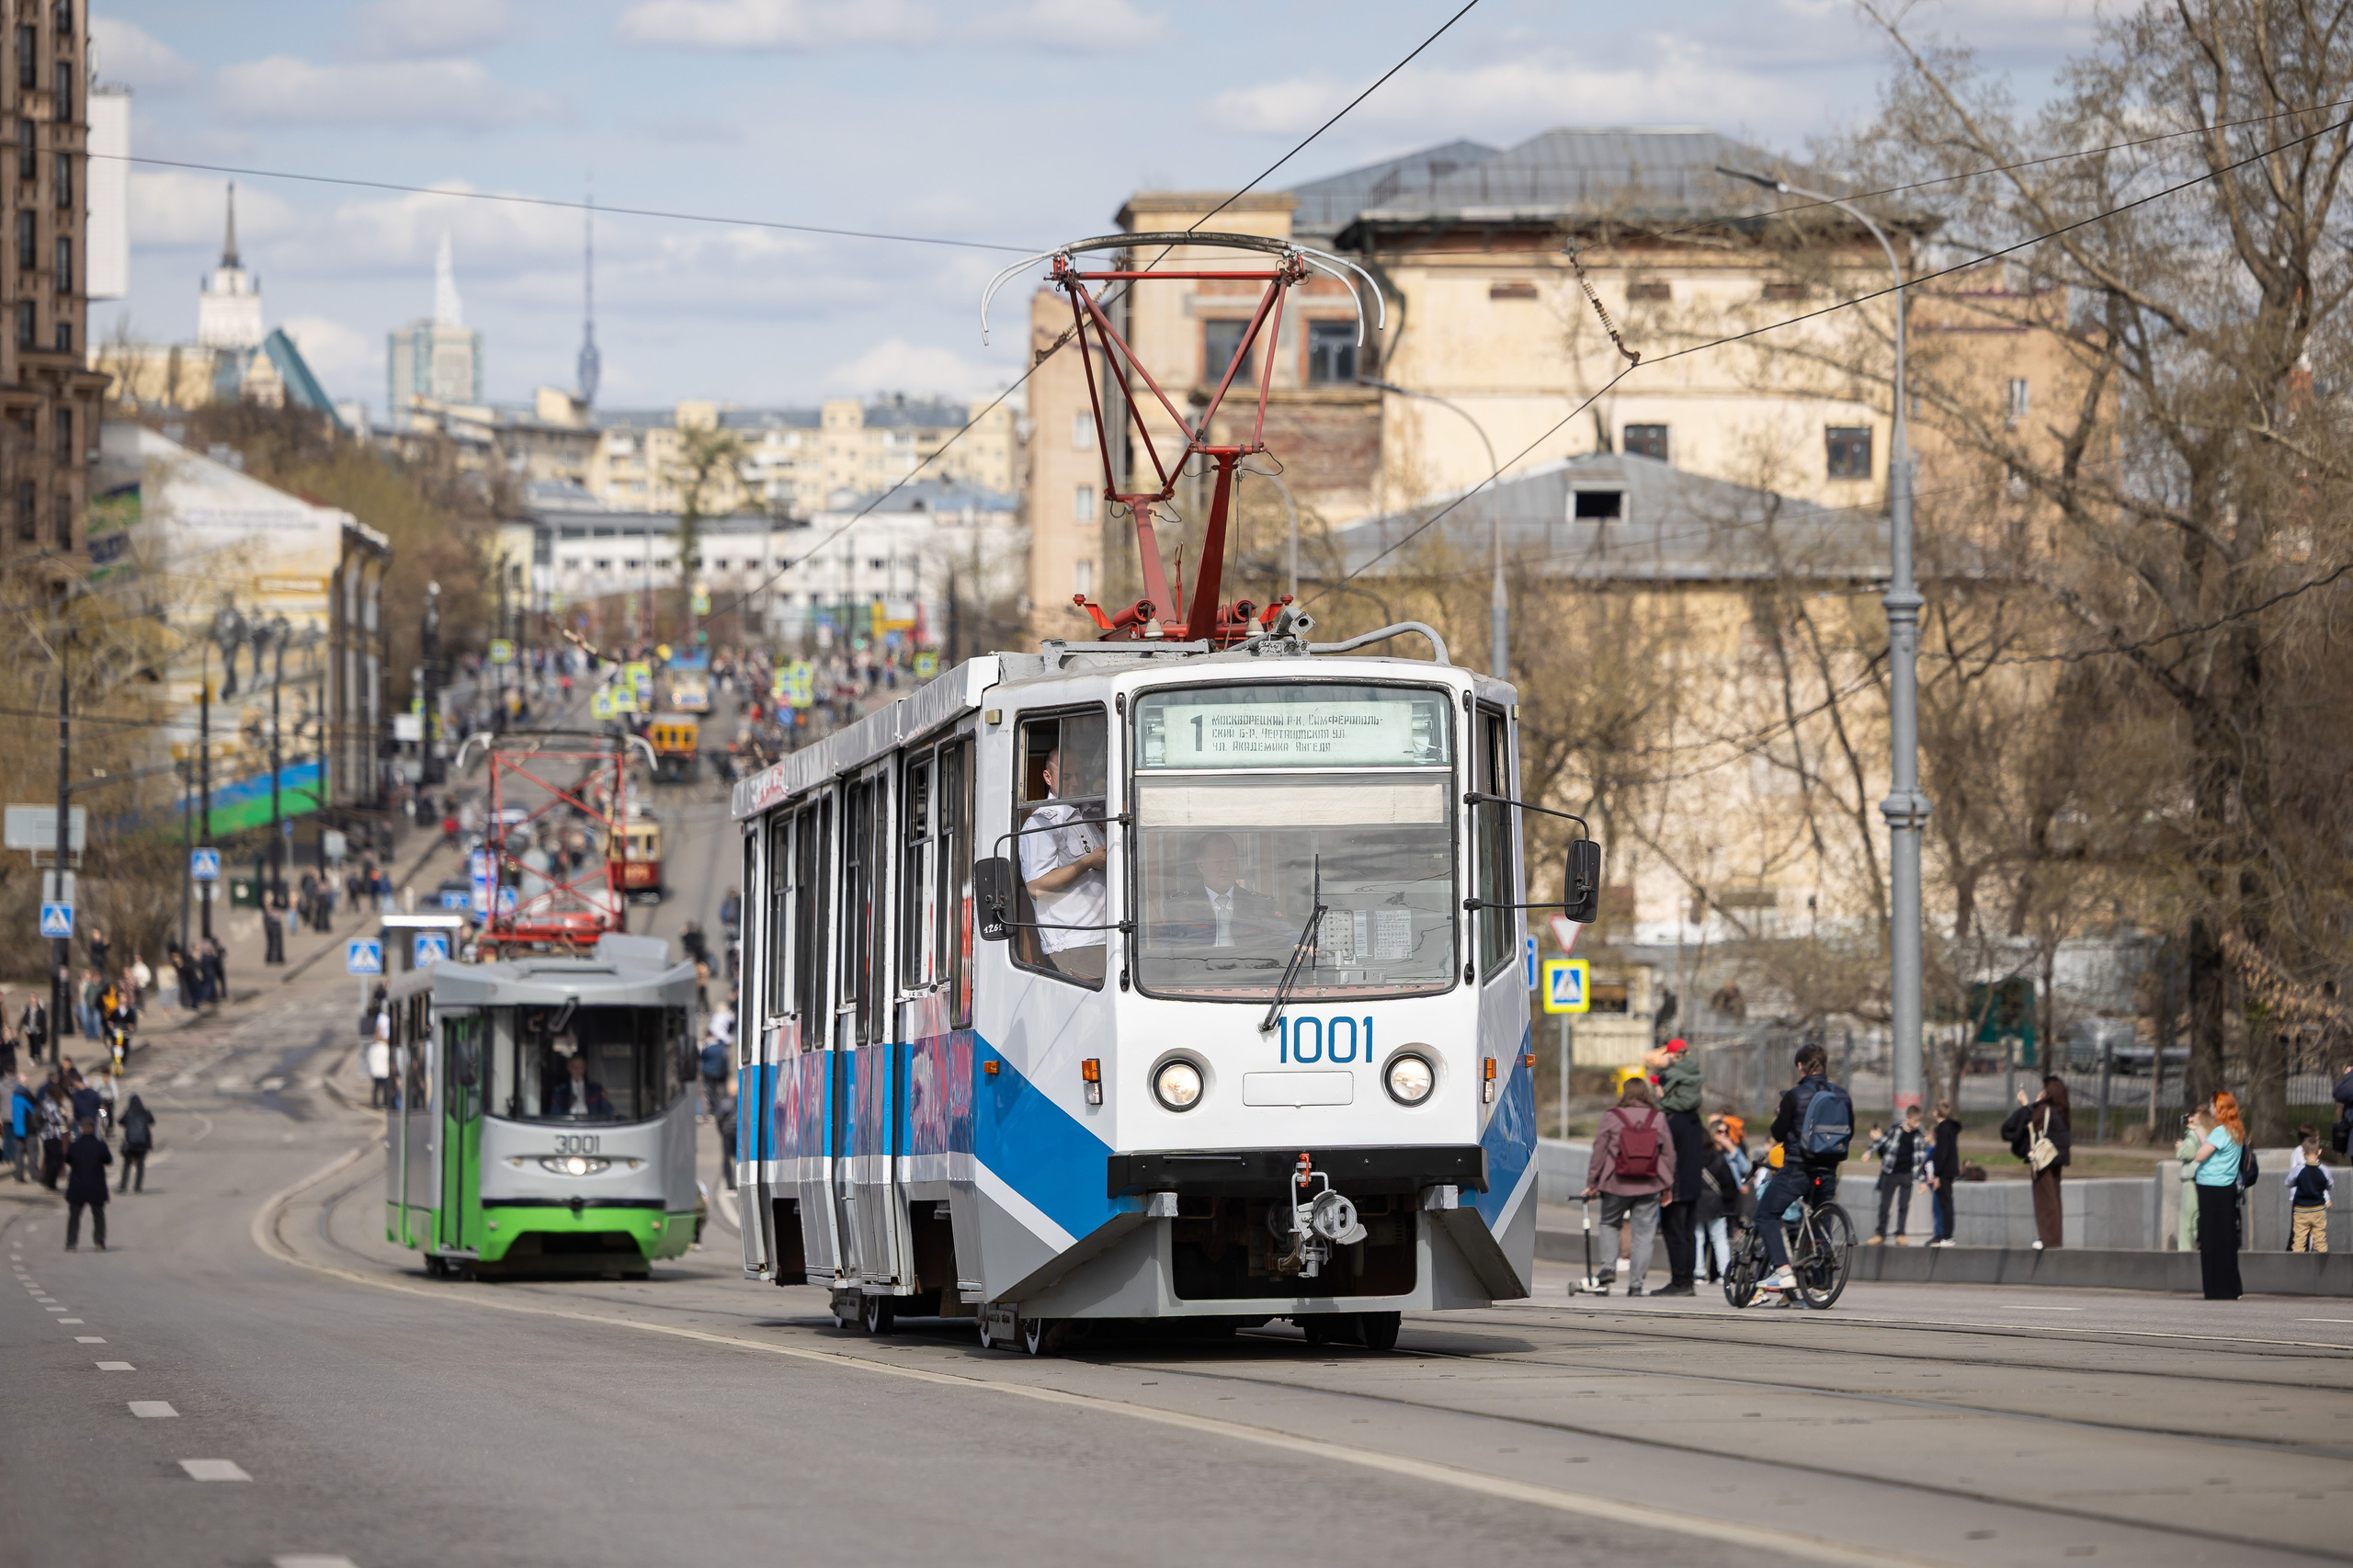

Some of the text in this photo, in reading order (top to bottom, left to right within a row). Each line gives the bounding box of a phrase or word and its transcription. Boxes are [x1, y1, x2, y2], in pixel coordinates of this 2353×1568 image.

[1190, 714, 1203, 752] 1
[983, 923, 1003, 934] 1261
[1278, 1016, 1372, 1063] 1001
[553, 1134, 600, 1154] 3001
